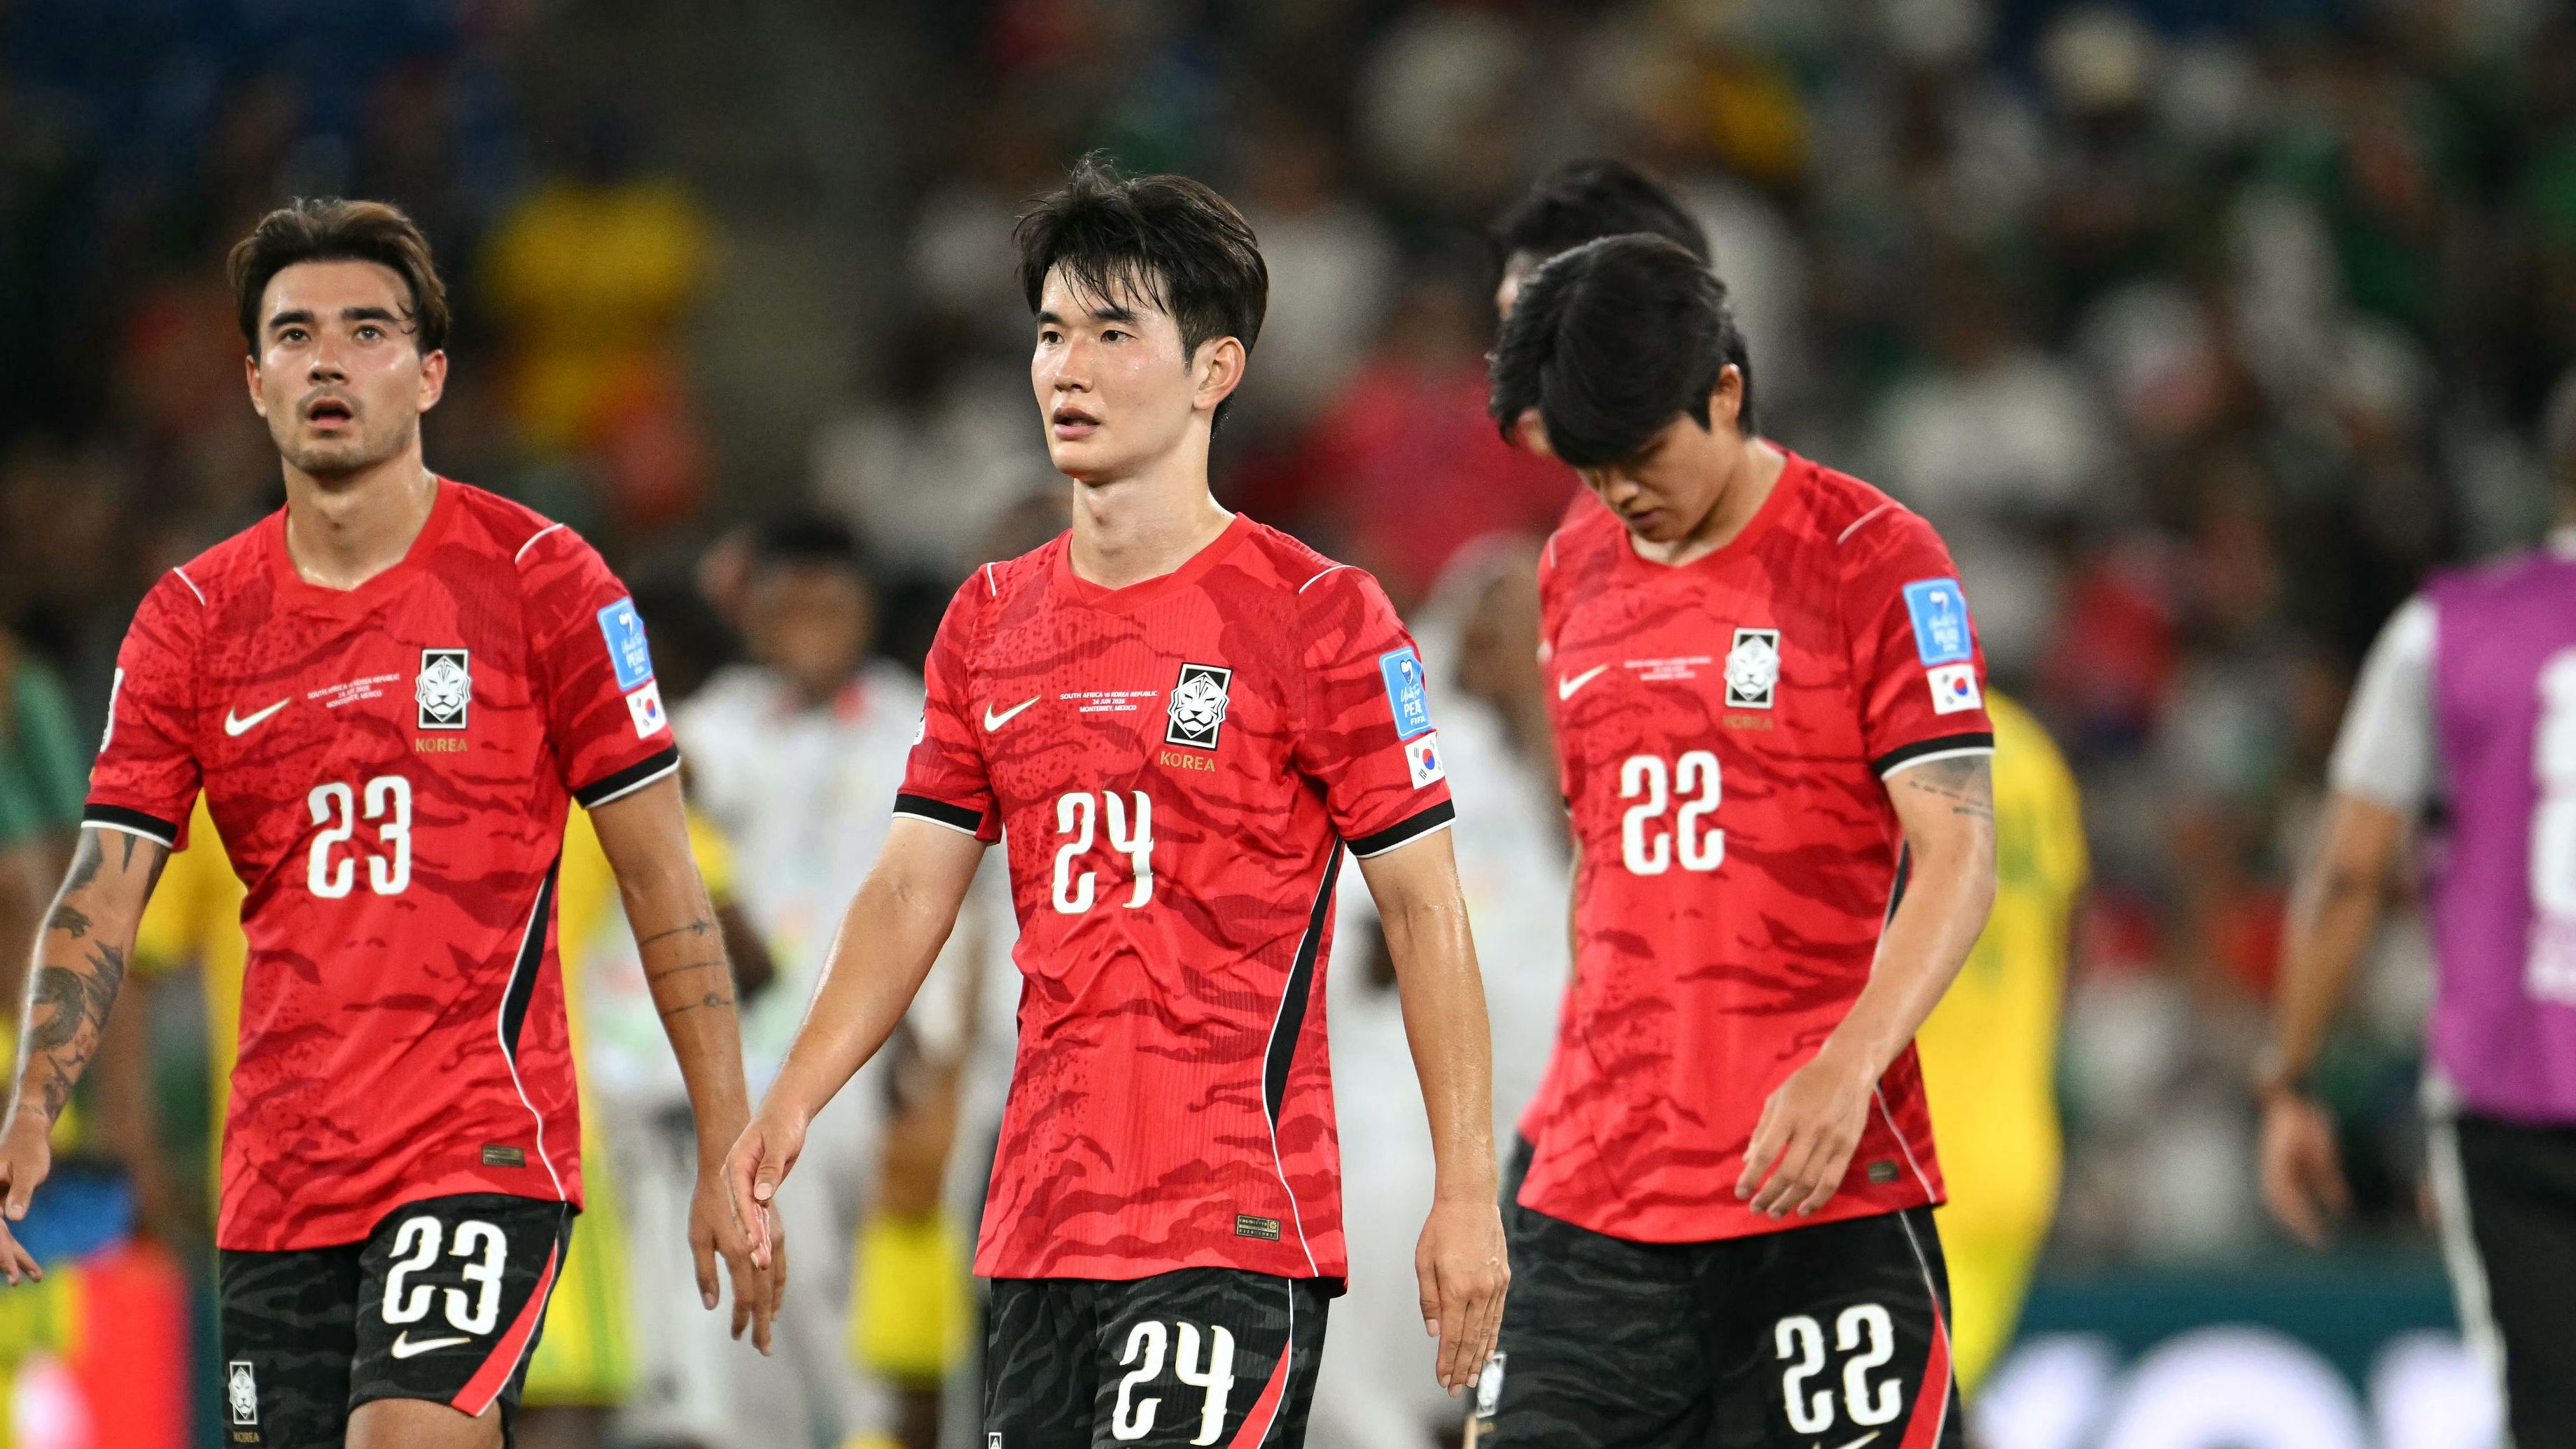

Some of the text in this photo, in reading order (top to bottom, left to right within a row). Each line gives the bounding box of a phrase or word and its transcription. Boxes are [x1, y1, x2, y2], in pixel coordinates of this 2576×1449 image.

[415, 738, 468, 752] KOREA
[1160, 751, 1215, 773] KOREA
[1410, 715, 1426, 725] FIFA
[307, 775, 412, 898] 23
[1052, 790, 1154, 915] 24
[1618, 750, 1725, 876] 22
[382, 1215, 507, 1335] 23
[1112, 1320, 1235, 1446] 24
[1774, 1303, 1903, 1434] 22
